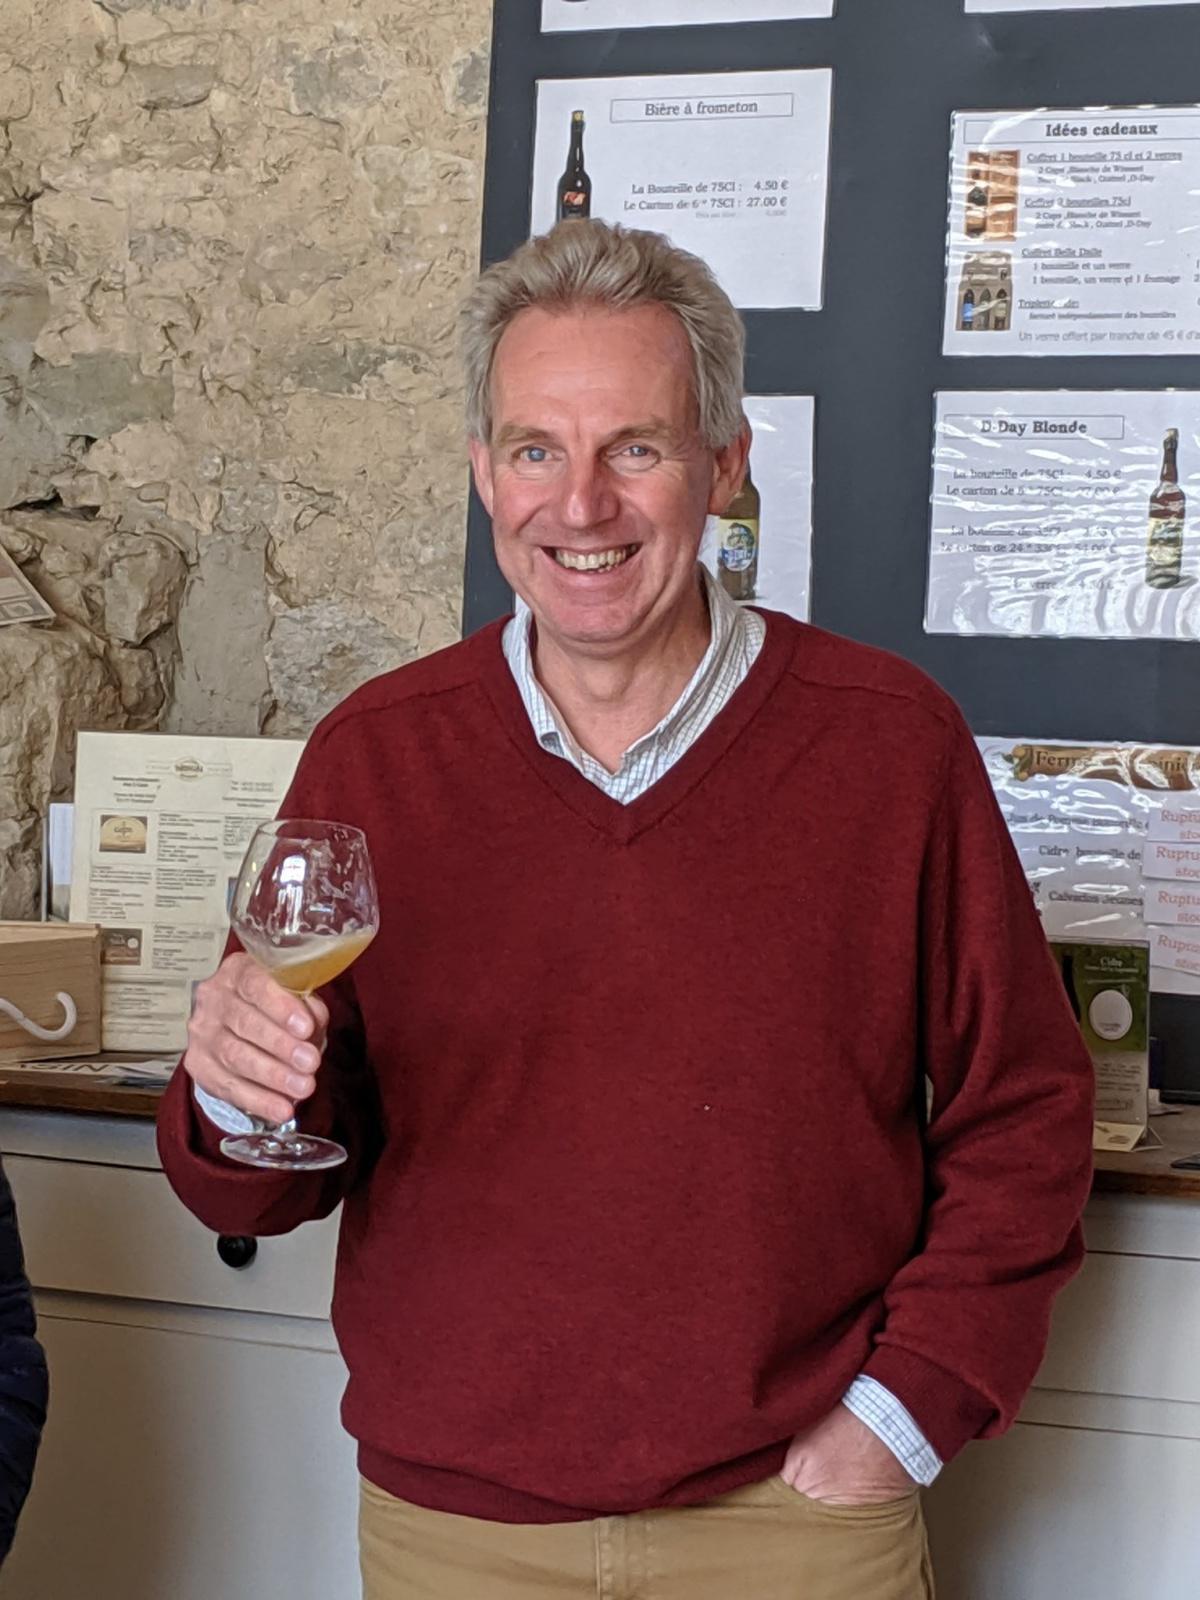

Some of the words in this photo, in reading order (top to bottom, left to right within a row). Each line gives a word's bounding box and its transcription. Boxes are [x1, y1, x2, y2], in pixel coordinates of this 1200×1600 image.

[644, 102, 680, 116] Bière
[684, 102, 694, 116] à
[696, 100, 758, 114] frometon
[1046, 124, 1088, 137] Idées
[1093, 124, 1158, 136] cadeaux
[1026, 152, 1057, 163] Coffret
[632, 184, 645, 194] La
[695, 182, 708, 193] de
[754, 180, 779, 191] 4.50
[780, 180, 789, 190] €
[624, 200, 637, 210] Le
[676, 199, 689, 209] de
[746, 196, 778, 208] 27.00
[780, 196, 788, 207] €
[1018, 331, 1033, 342] Un
[1034, 332, 1060, 342] verre
[1062, 330, 1088, 342] offert
[1090, 332, 1107, 343] par
[1109, 330, 1146, 341] tranche
[1146, 330, 1160, 340] de
[1162, 330, 1174, 340] 45
[1032, 420, 1088, 434] Blonde
[946, 484, 960, 496] Le
[961, 486, 997, 496] carton
[1038, 844, 1070, 856] Cidre
[1127, 848, 1141, 860] de
